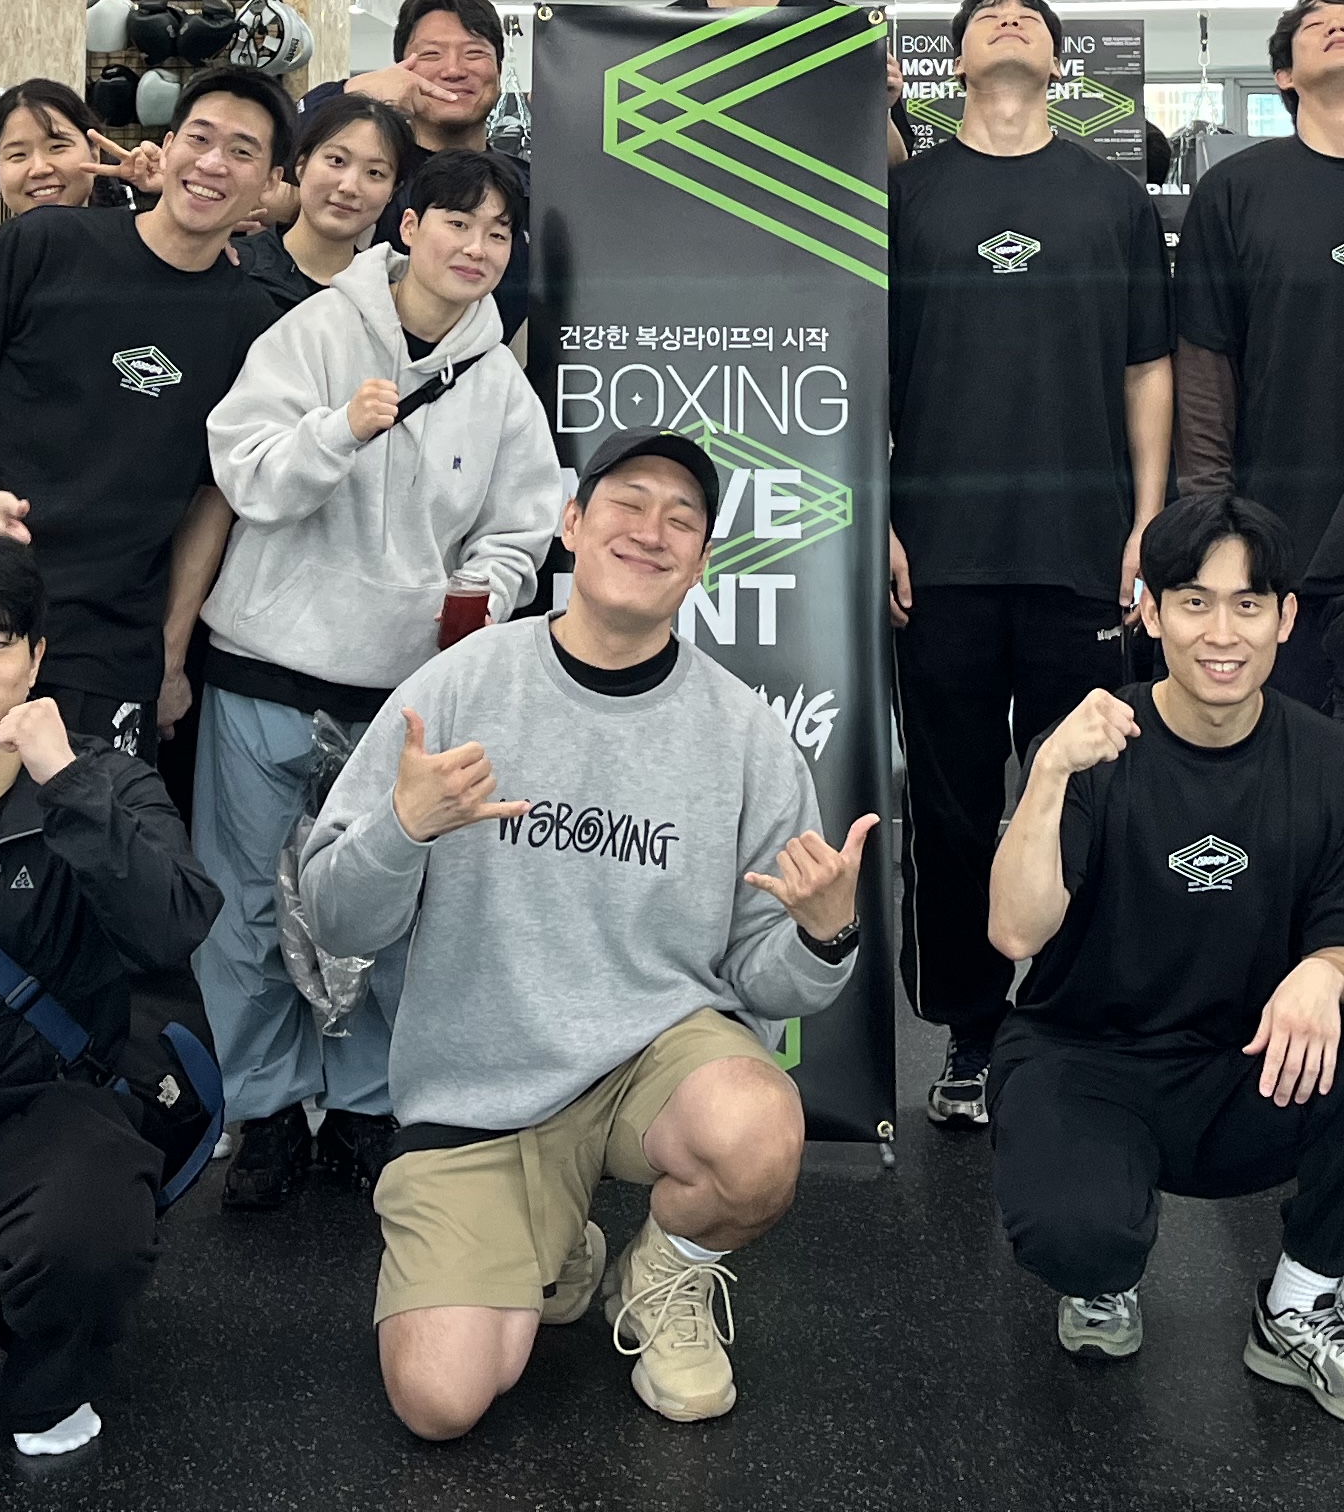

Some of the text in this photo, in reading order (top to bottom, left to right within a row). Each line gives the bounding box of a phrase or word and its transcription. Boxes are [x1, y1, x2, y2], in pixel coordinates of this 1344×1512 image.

[902, 36, 955, 53] BOXIN
[902, 82, 958, 99] MENT
[559, 325, 829, 352] 건강한 복싱라이프의 시작
[556, 364, 850, 435] BOXING
